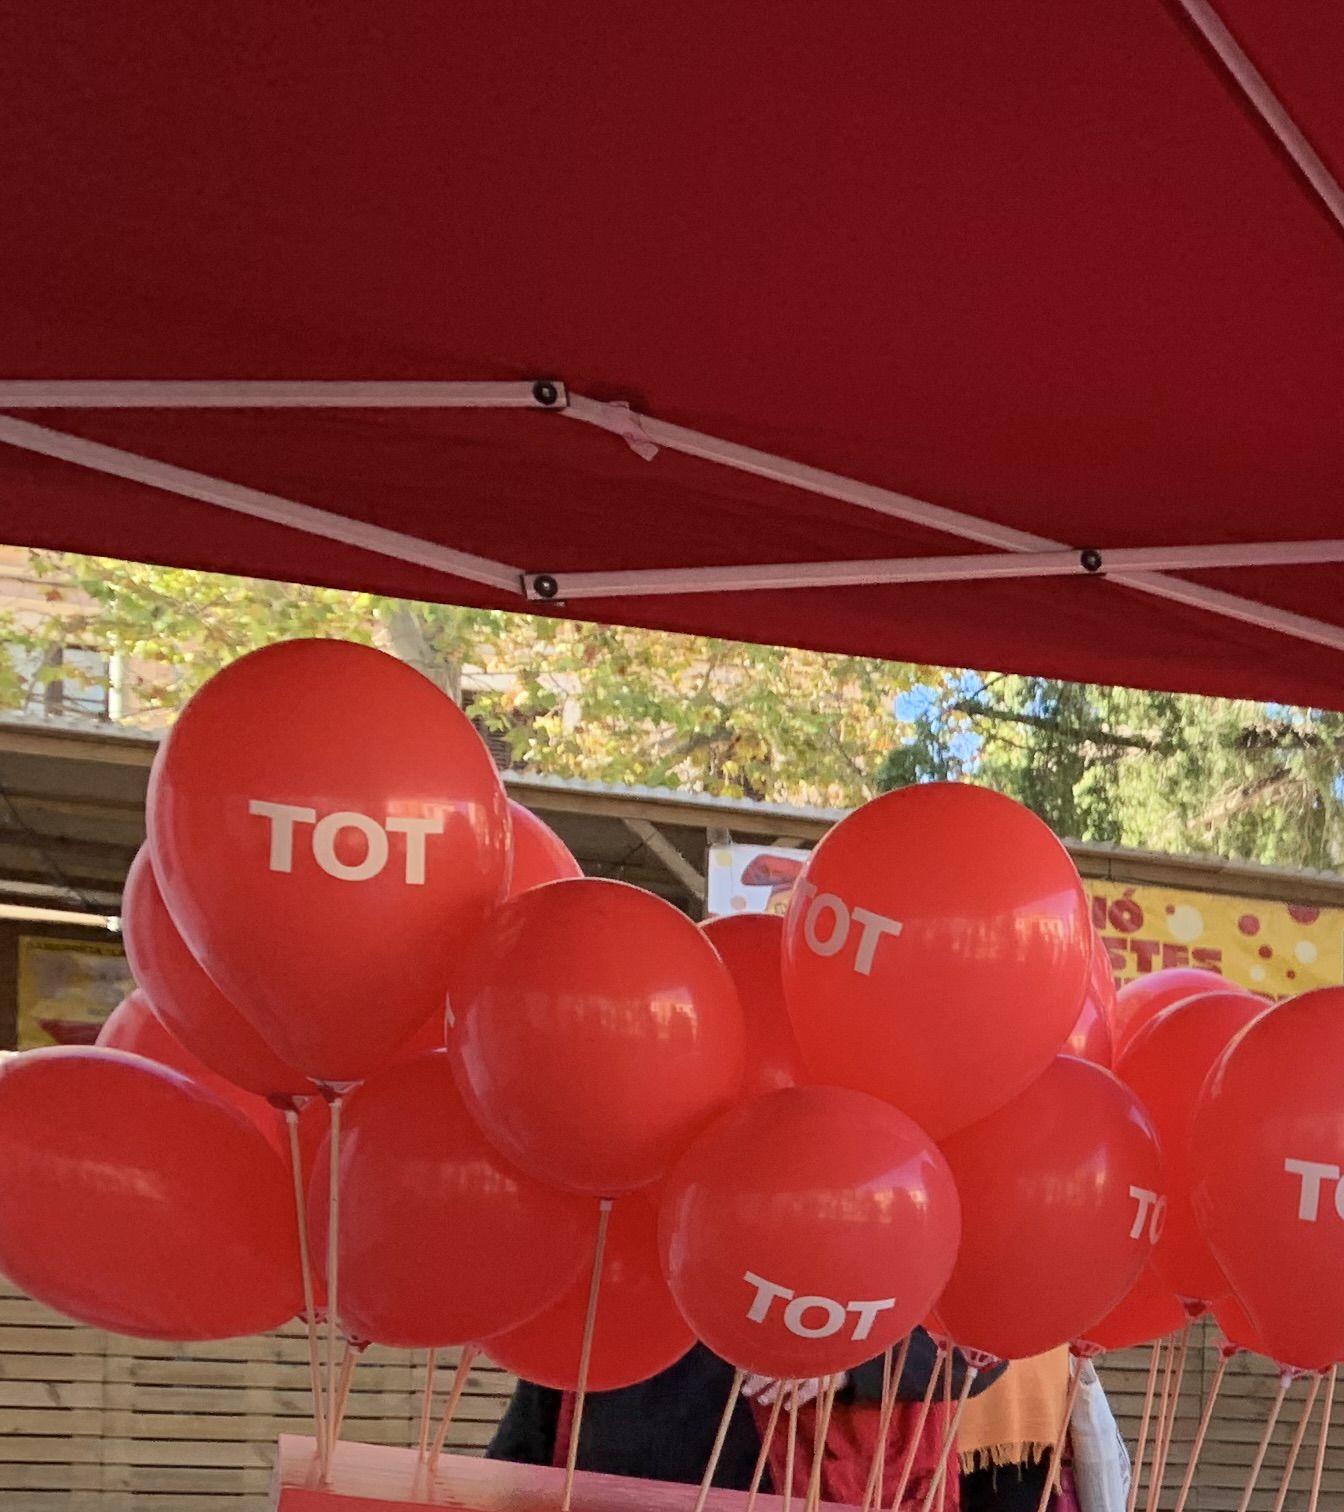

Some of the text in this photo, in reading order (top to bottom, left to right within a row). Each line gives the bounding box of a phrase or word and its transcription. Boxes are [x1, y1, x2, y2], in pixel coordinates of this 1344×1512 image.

[248, 800, 444, 885] TOT
[1092, 887, 1143, 934] IÓ
[1129, 1185, 1168, 1246] TO
[743, 1271, 896, 1341] TOT
